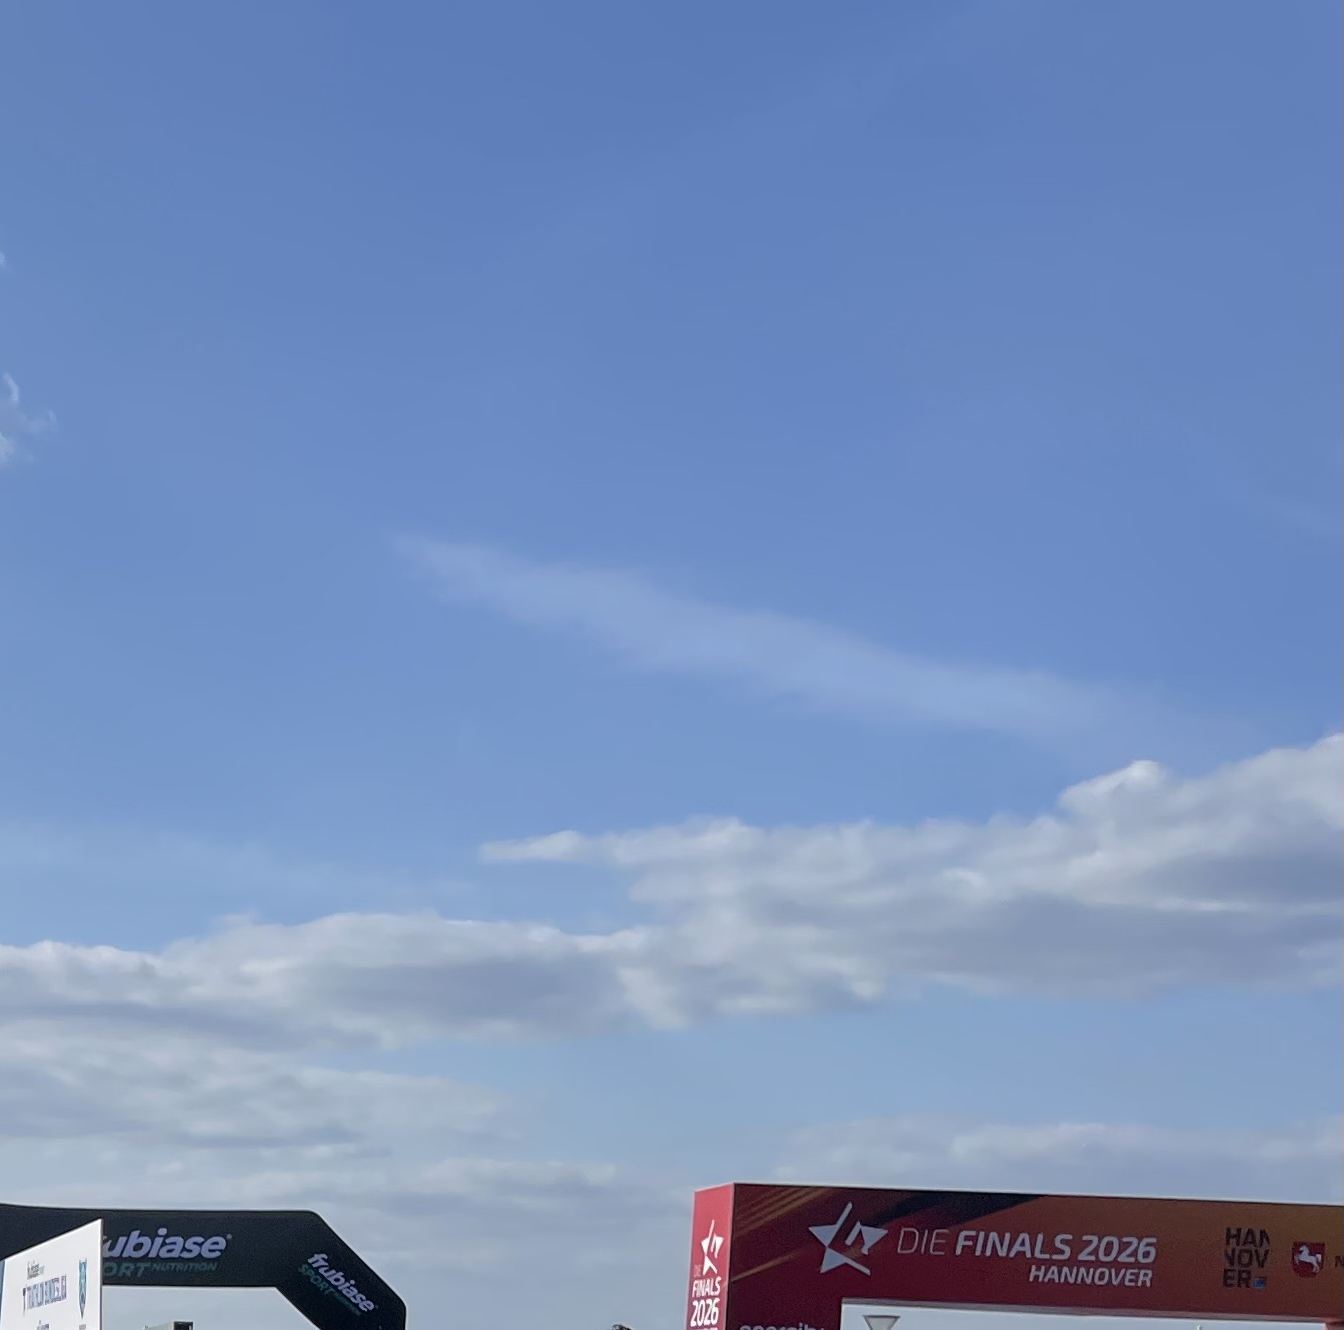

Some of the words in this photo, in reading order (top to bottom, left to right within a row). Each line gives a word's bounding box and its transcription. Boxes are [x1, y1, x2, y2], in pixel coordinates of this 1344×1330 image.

[103, 1228, 227, 1258] ubiase
[897, 1228, 949, 1255] DIE
[955, 1230, 1073, 1260] FINALS
[1078, 1235, 1157, 1264] 2026
[103, 1262, 151, 1278] ORT
[308, 1252, 374, 1312] frubiase
[1028, 1264, 1152, 1287] HANNOVER
[691, 1277, 722, 1298] FINALS
[690, 1298, 721, 1328] 2026
